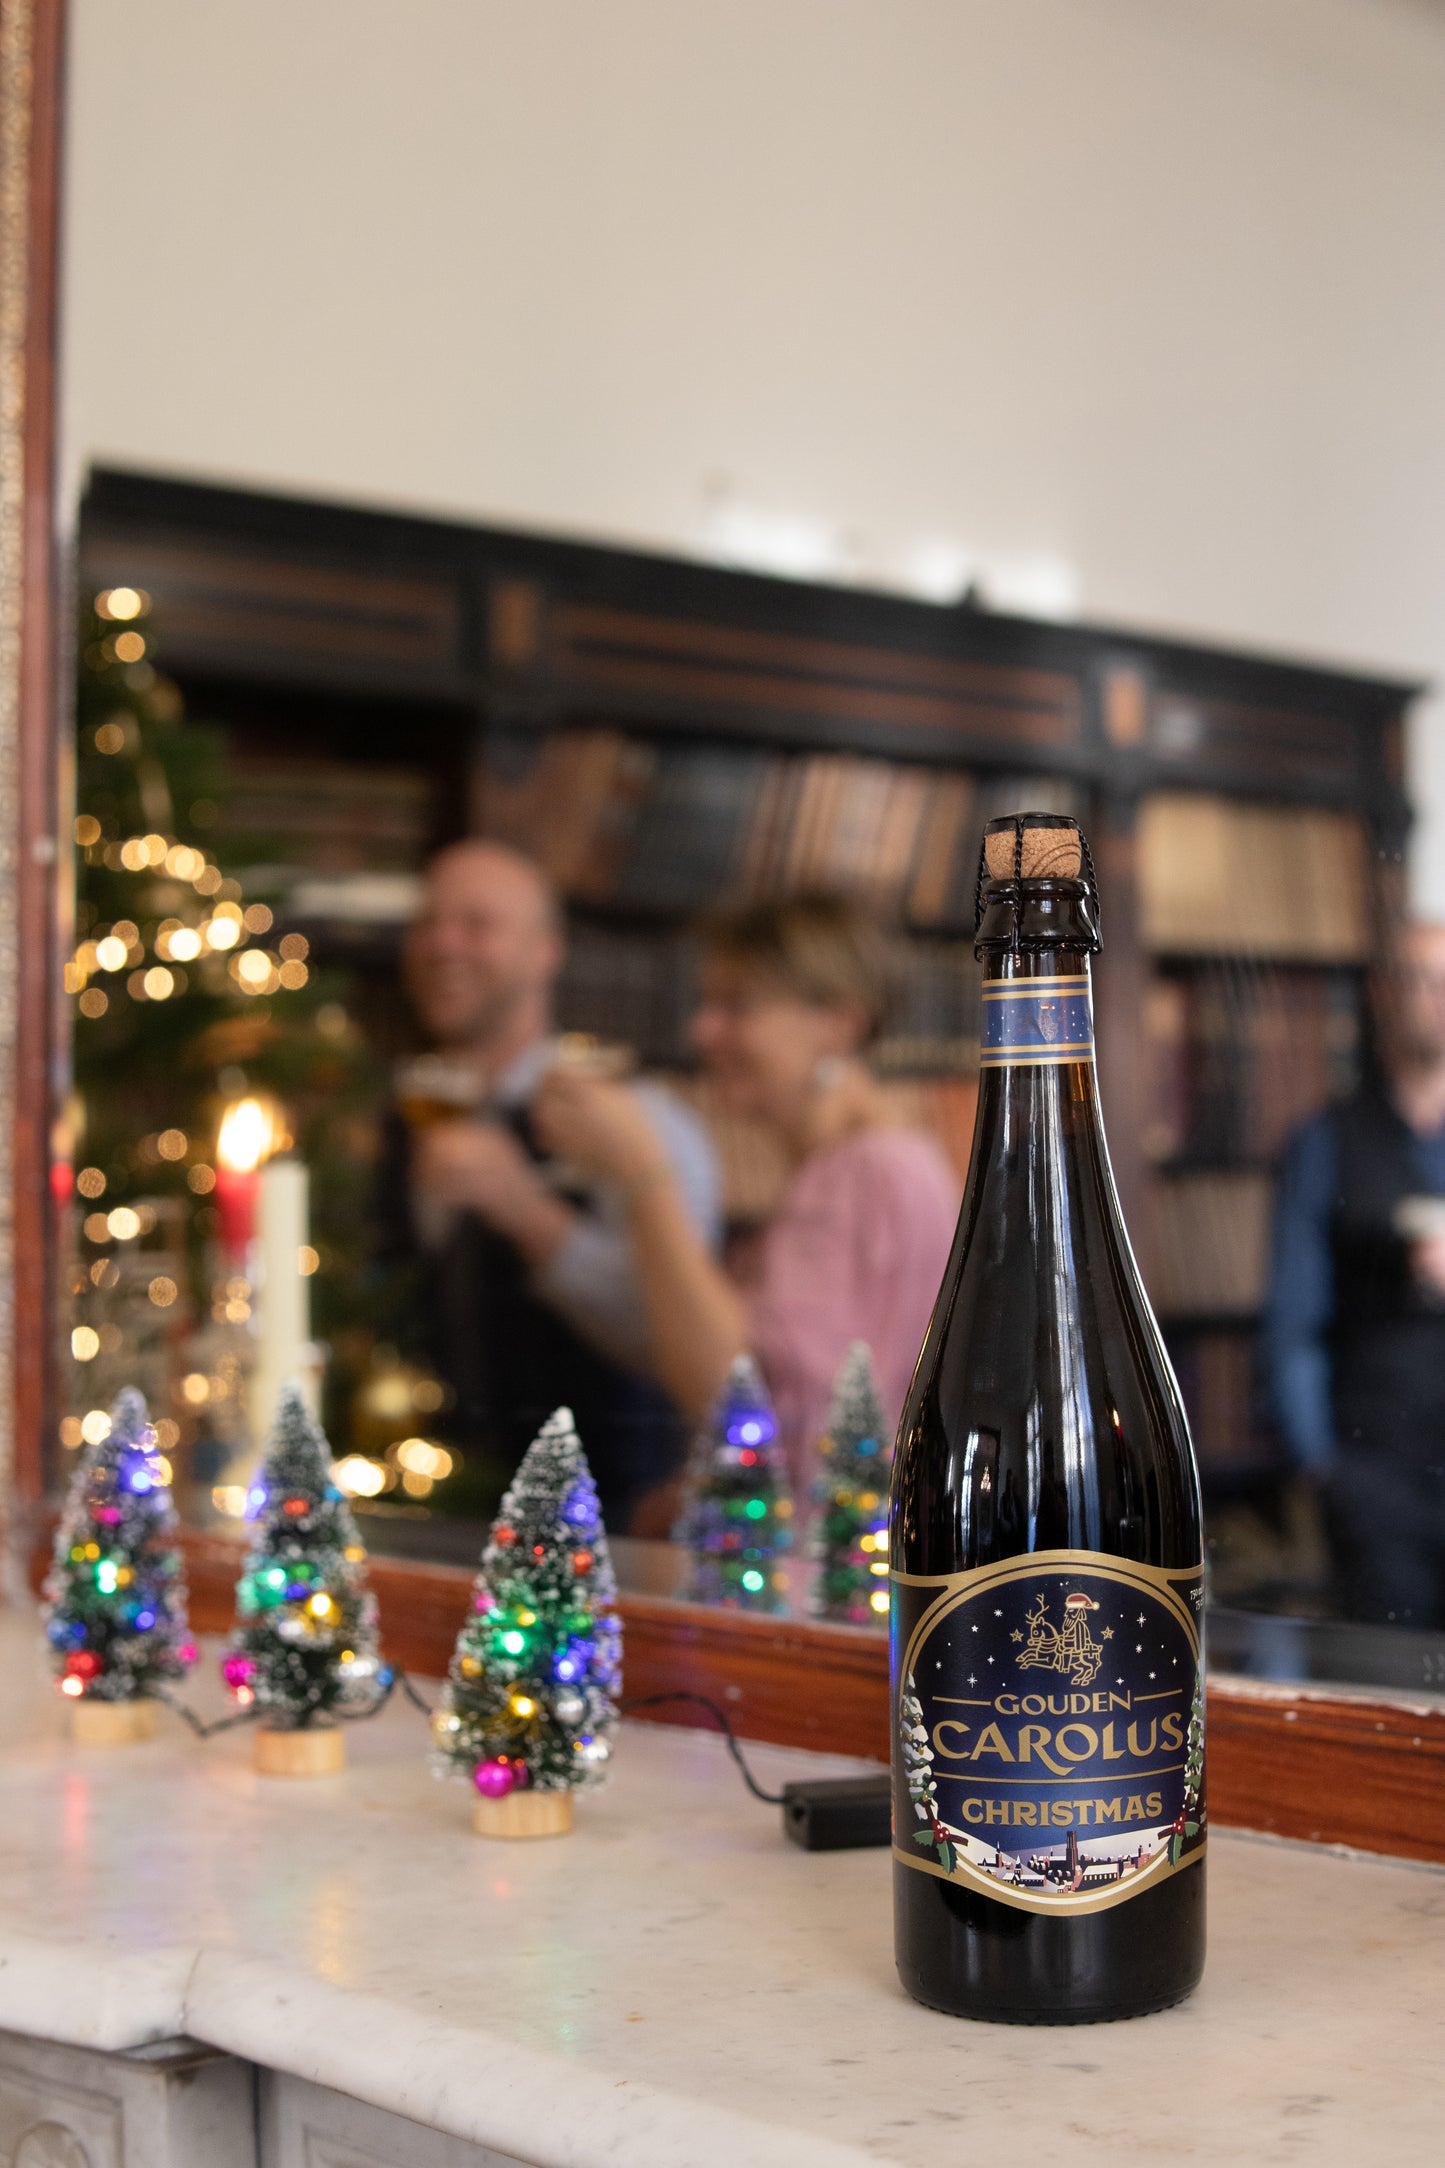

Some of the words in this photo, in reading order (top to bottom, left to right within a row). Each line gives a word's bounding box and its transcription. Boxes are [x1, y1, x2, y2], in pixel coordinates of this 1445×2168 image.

[994, 1689, 1131, 1715] GOUDEN
[932, 1712, 1184, 1776] CAROLUS
[962, 1792, 1163, 1826] CHRISTMAS
